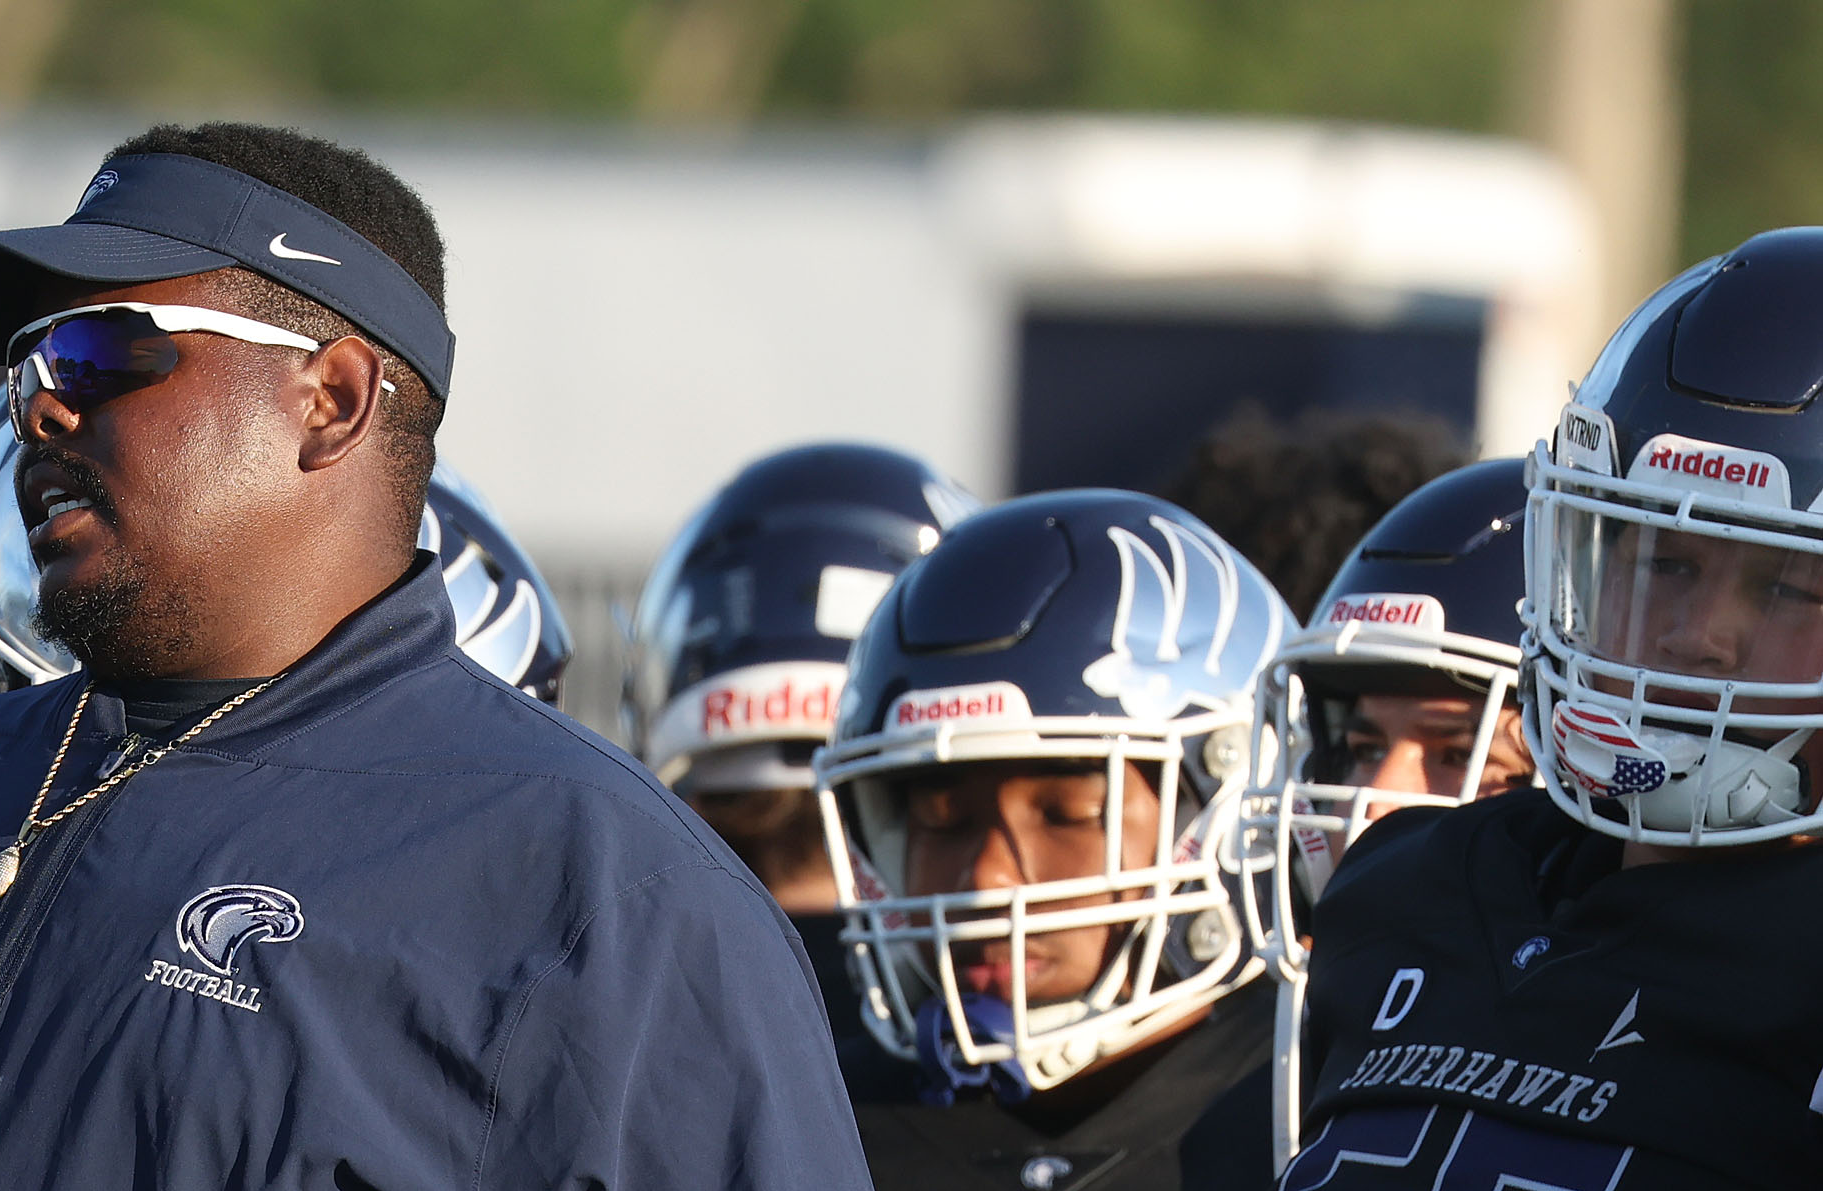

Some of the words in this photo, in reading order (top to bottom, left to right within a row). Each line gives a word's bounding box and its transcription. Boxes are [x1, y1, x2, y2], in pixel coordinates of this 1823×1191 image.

[1648, 445, 1770, 488] Riddell
[1330, 598, 1423, 624] Riddell
[898, 693, 1003, 726] Riddell
[144, 959, 263, 1013] FOOTBALL
[1371, 967, 1425, 1031] D
[1339, 1043, 1618, 1123] SILVERHAWKS
